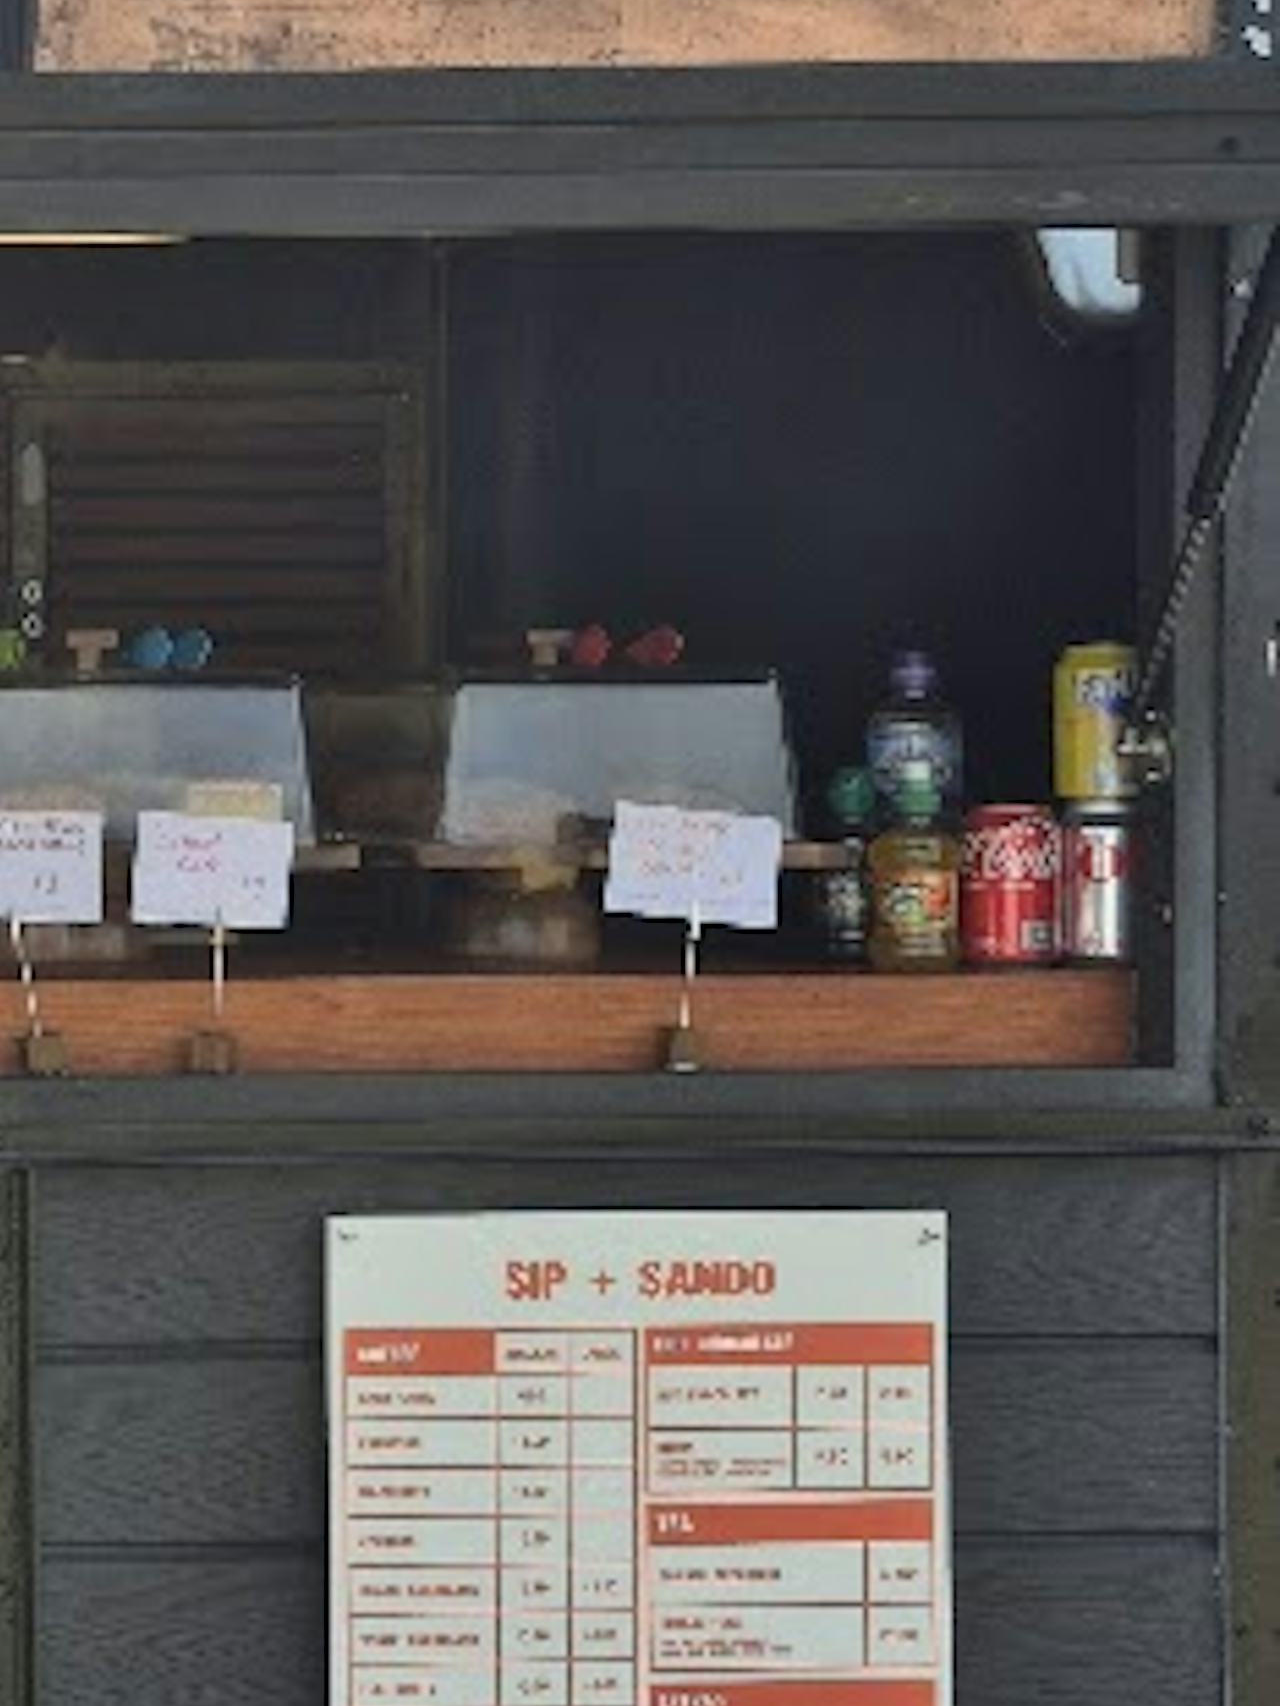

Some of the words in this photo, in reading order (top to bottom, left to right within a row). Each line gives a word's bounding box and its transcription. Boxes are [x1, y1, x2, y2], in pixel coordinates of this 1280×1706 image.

[506, 1261, 566, 1299] SIP
[589, 1269, 616, 1295] +
[638, 1260, 775, 1297] SANDO
